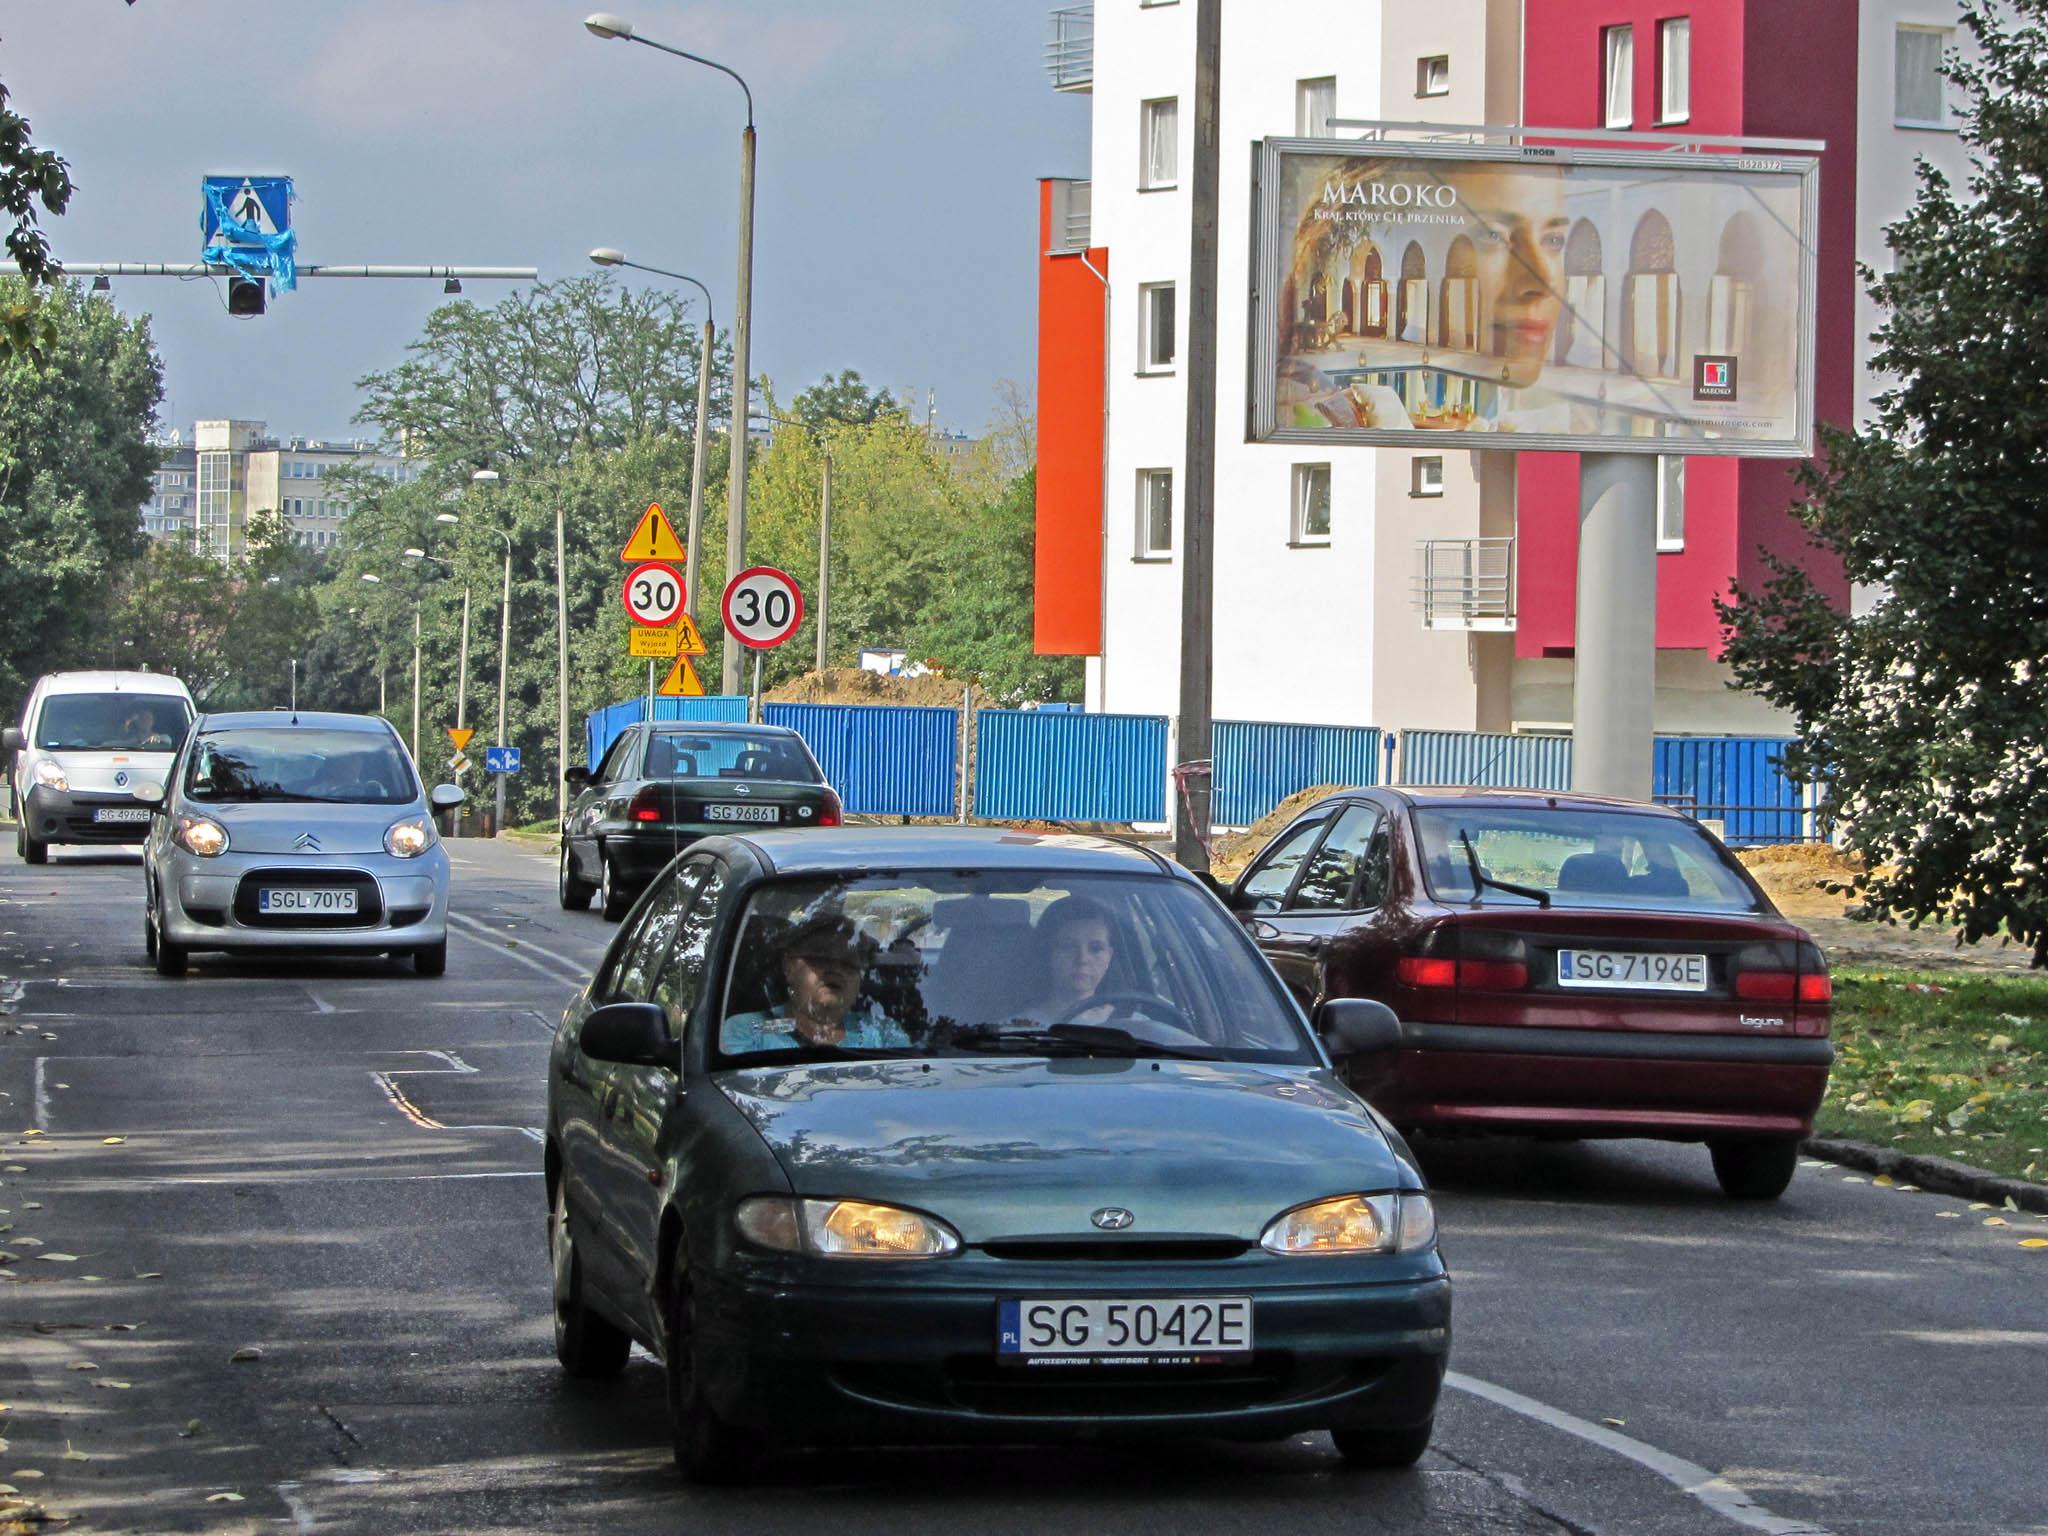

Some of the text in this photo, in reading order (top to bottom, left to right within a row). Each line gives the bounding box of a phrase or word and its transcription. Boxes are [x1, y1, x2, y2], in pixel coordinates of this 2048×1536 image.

[1322, 180, 1457, 208] MAROKO
[633, 580, 675, 611] 30
[735, 588, 791, 628] 30
[100, 809, 149, 820] SG 4966E
[712, 806, 776, 821] SG 96861
[271, 892, 306, 908] SGL
[313, 892, 353, 908] 70Y5
[1576, 954, 1701, 983] SG 7196E
[1002, 1331, 1018, 1344] PL
[1028, 1303, 1244, 1346] SG 5042E
